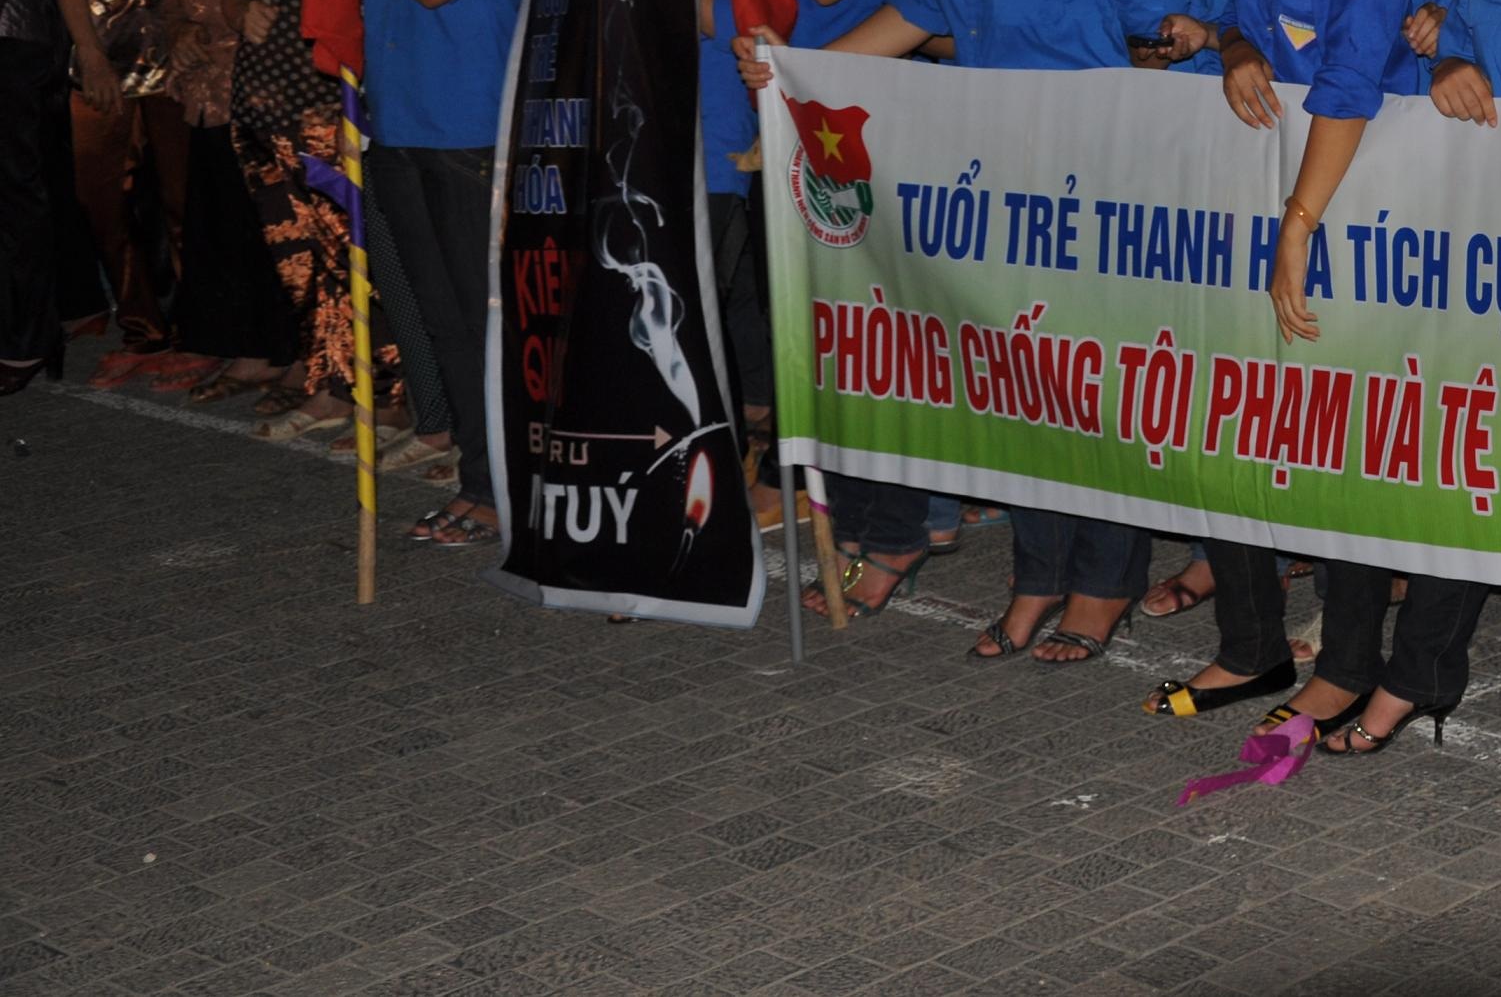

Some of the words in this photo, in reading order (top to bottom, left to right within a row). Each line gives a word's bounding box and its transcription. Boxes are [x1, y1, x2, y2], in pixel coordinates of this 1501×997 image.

[897, 158, 990, 262] TUỔI
[1004, 174, 1079, 270] TRẺ
[1095, 201, 1233, 288] THANH
[1248, 215, 1334, 299] HA
[1347, 210, 1449, 310] TÍCH
[812, 285, 953, 407] PHÒNG
[959, 302, 1102, 436] CHỐNG
[1118, 327, 1196, 469] TỘI
[1204, 353, 1354, 489] PHẠM
[1362, 353, 1424, 485] VÀ
[1437, 365, 1498, 515] TỆ
